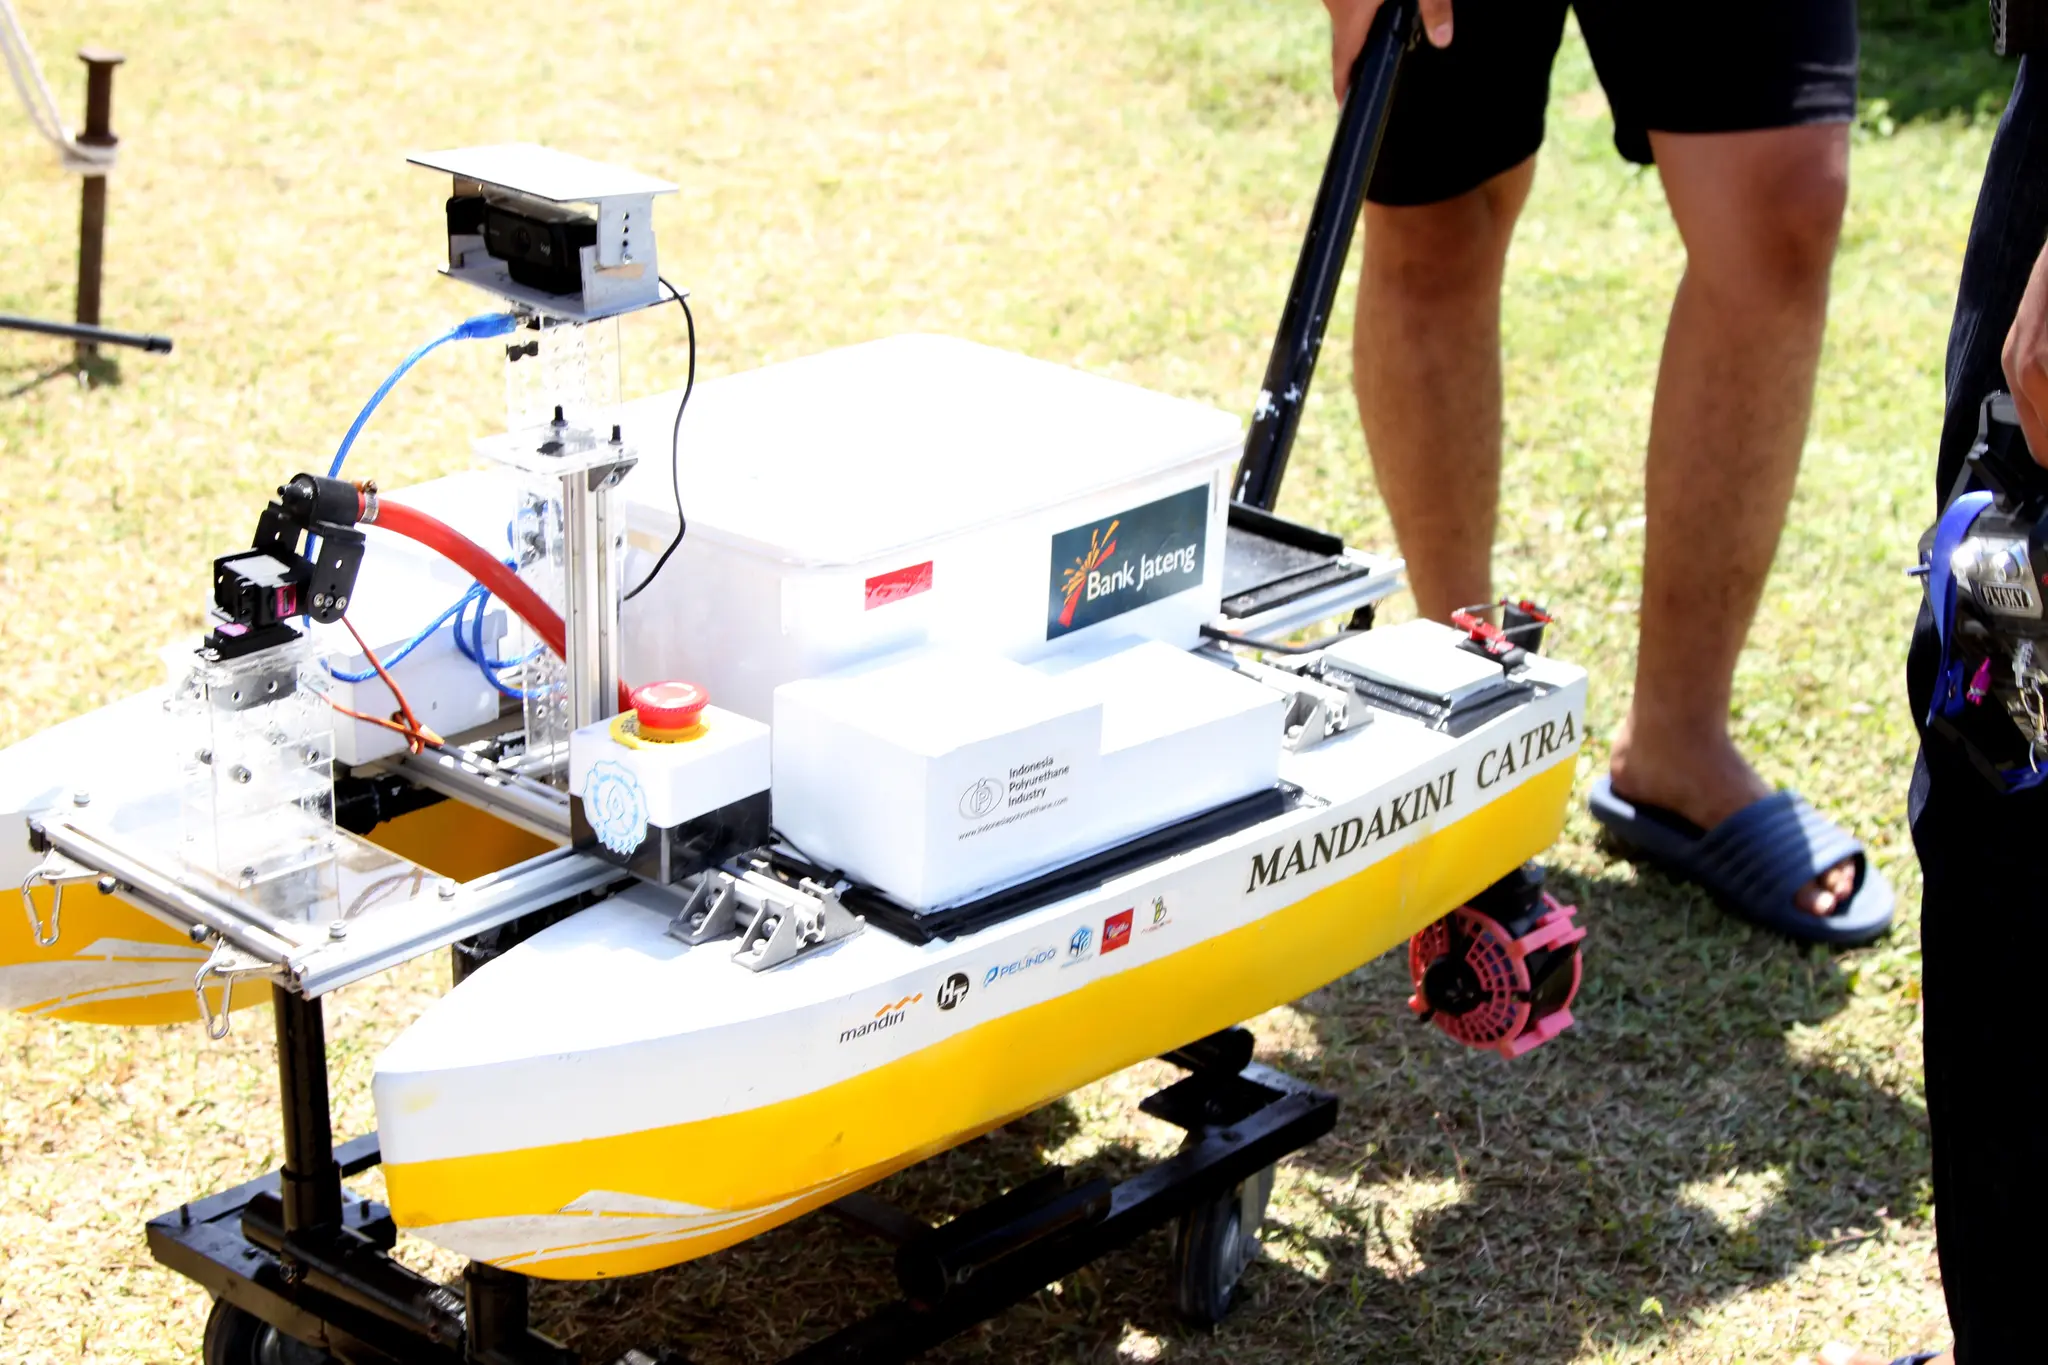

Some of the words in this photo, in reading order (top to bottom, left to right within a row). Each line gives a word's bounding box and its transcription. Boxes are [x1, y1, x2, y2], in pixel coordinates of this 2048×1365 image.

[1086, 560, 1135, 602] Bank
[1136, 543, 1197, 592] Jateng
[1982, 585, 2026, 609] FLYSKY
[1008, 755, 1054, 780] Indonesia
[1008, 765, 1070, 794] Polyurethane
[1007, 787, 1047, 808] Industry
[1246, 768, 1458, 893] MANDAKINI
[1476, 711, 1576, 789] CATRA
[1000, 947, 1056, 978] PELINDO
[839, 1010, 905, 1044] mandiri
